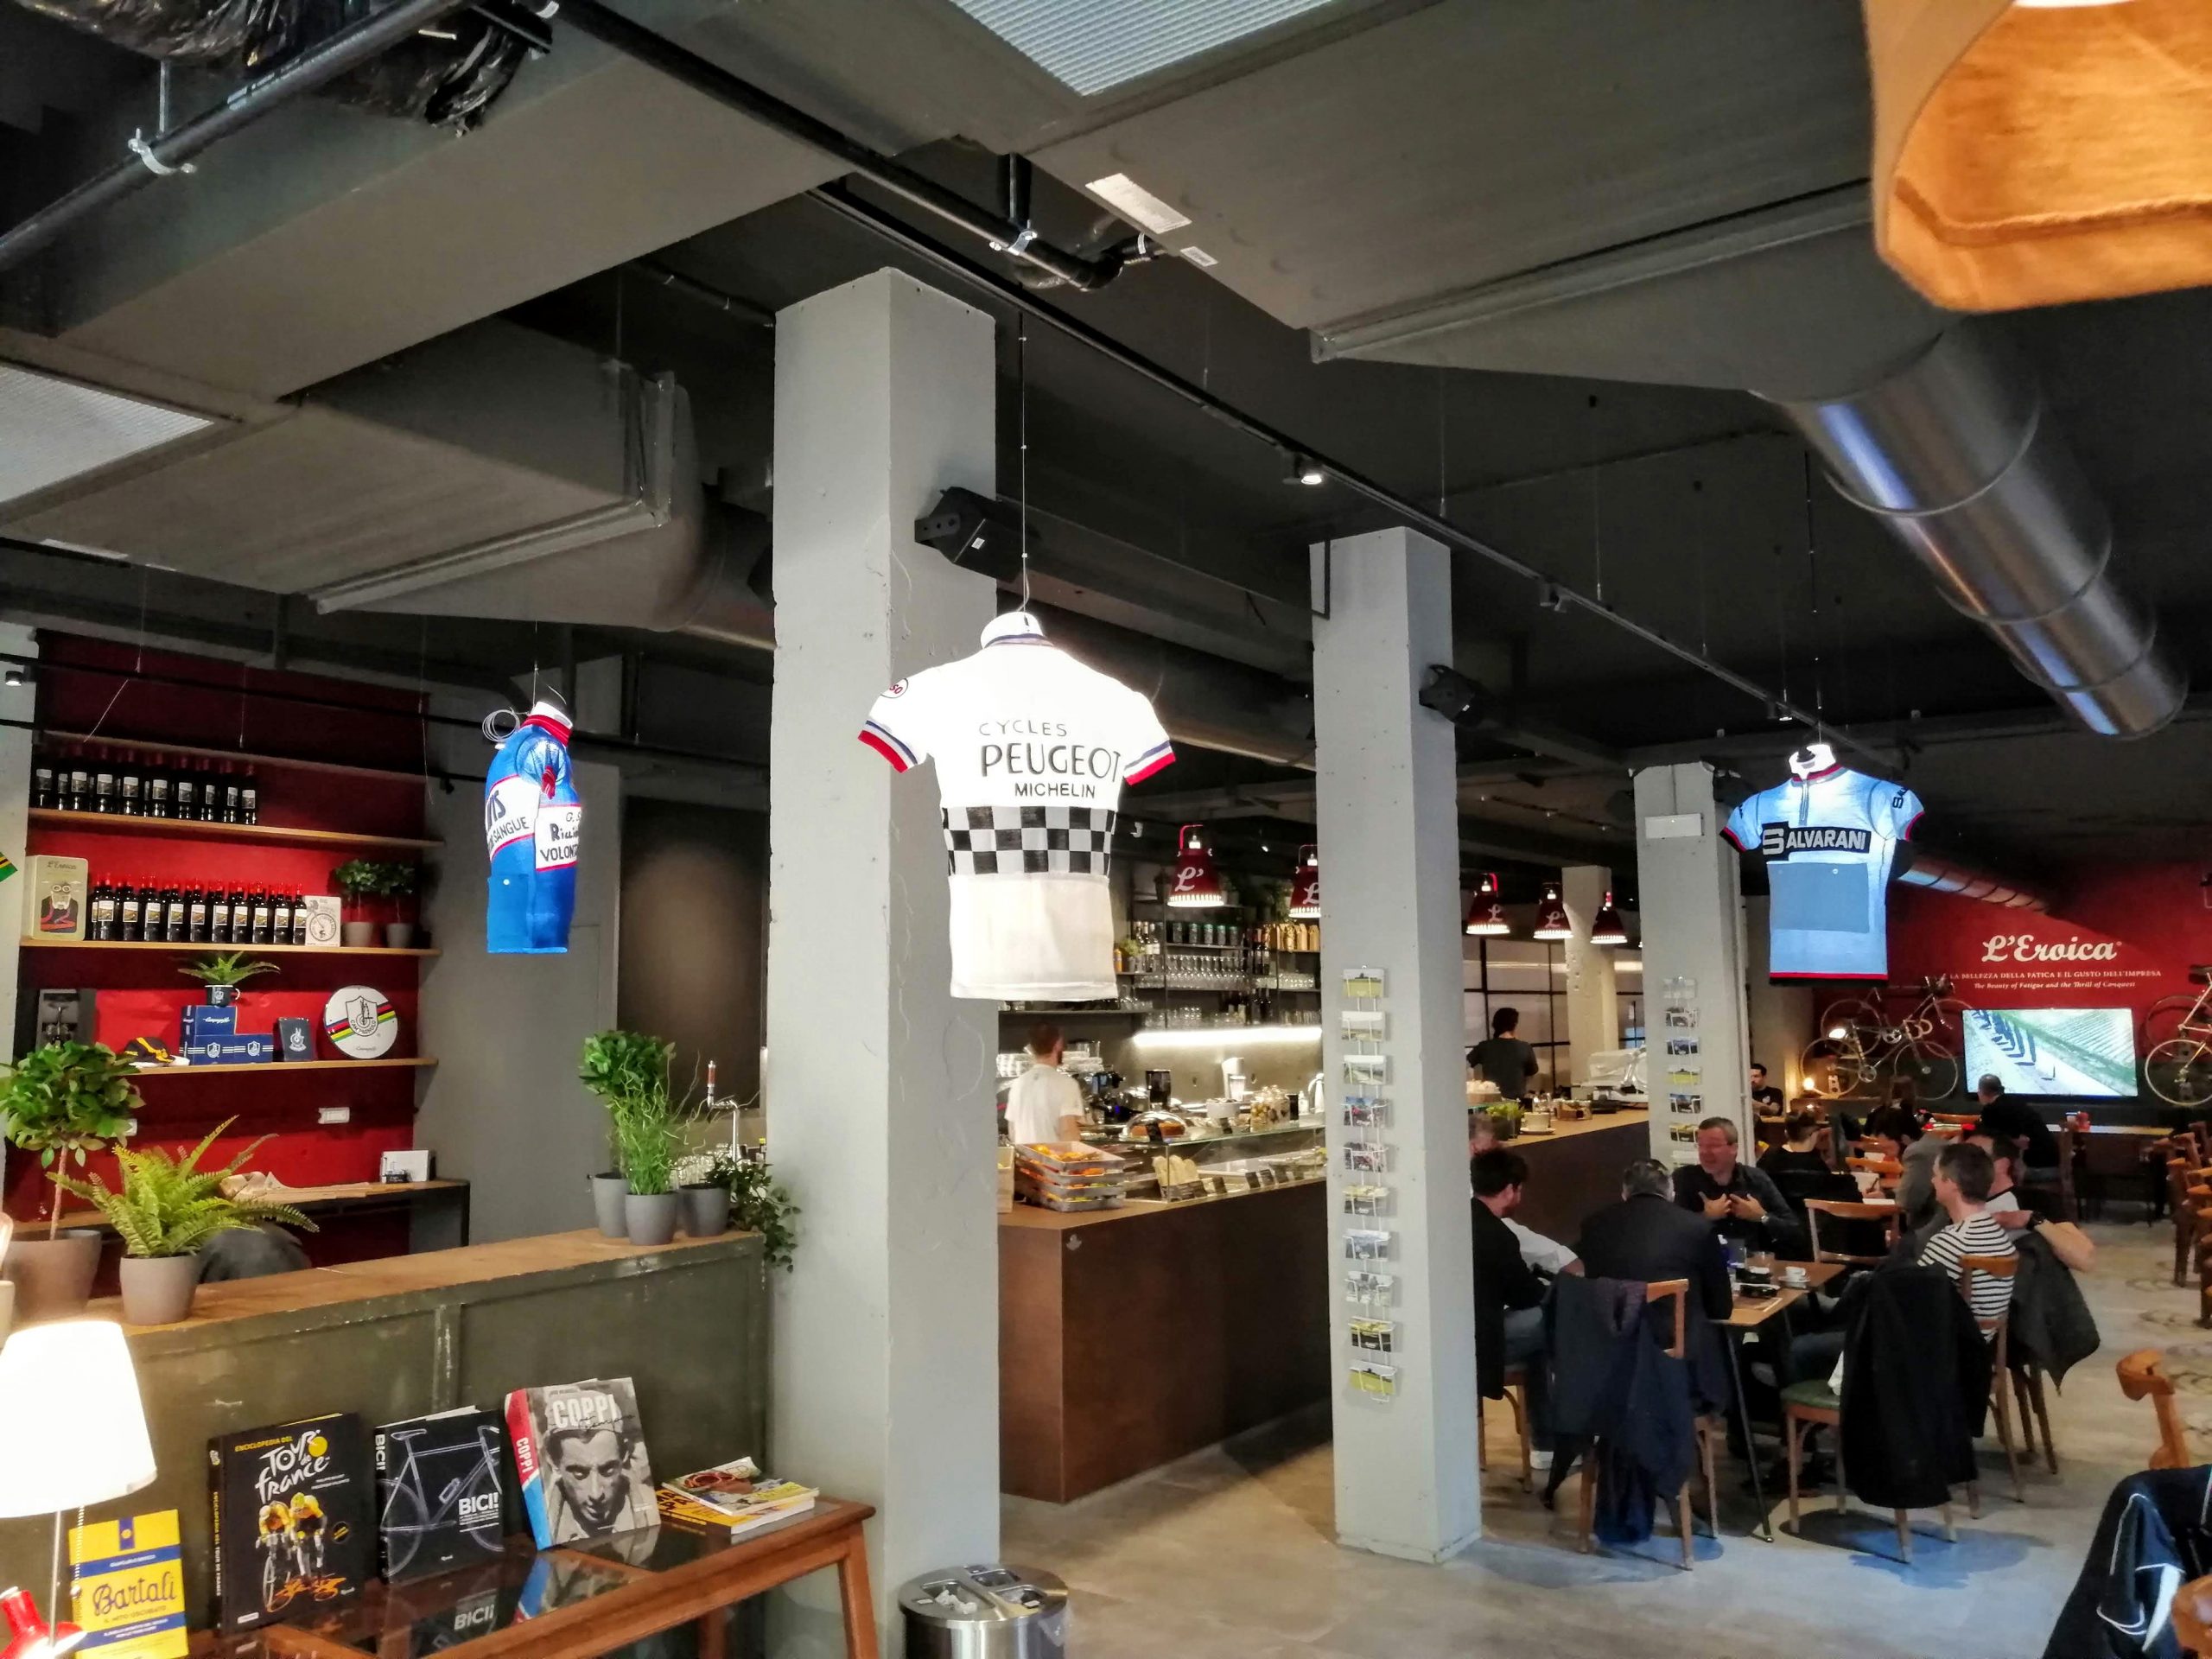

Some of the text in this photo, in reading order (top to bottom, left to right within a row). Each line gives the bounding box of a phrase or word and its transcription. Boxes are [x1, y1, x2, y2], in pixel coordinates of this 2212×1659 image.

[979, 720, 1067, 736] CYCLES
[981, 743, 1122, 783] PEUGEOT
[1014, 783, 1096, 799] MICHELIN
[493, 817, 530, 843] SANGUE
[1763, 828, 1866, 855] SALVARANI
[1981, 934, 2118, 963] L'Eroica
[553, 1394, 617, 1428] COPPI
[375, 1433, 386, 1471] BICI!
[516, 1437, 534, 1473] COPPI
[459, 1492, 499, 1516] BICI!
[92, 1571, 177, 1617] Bartali
